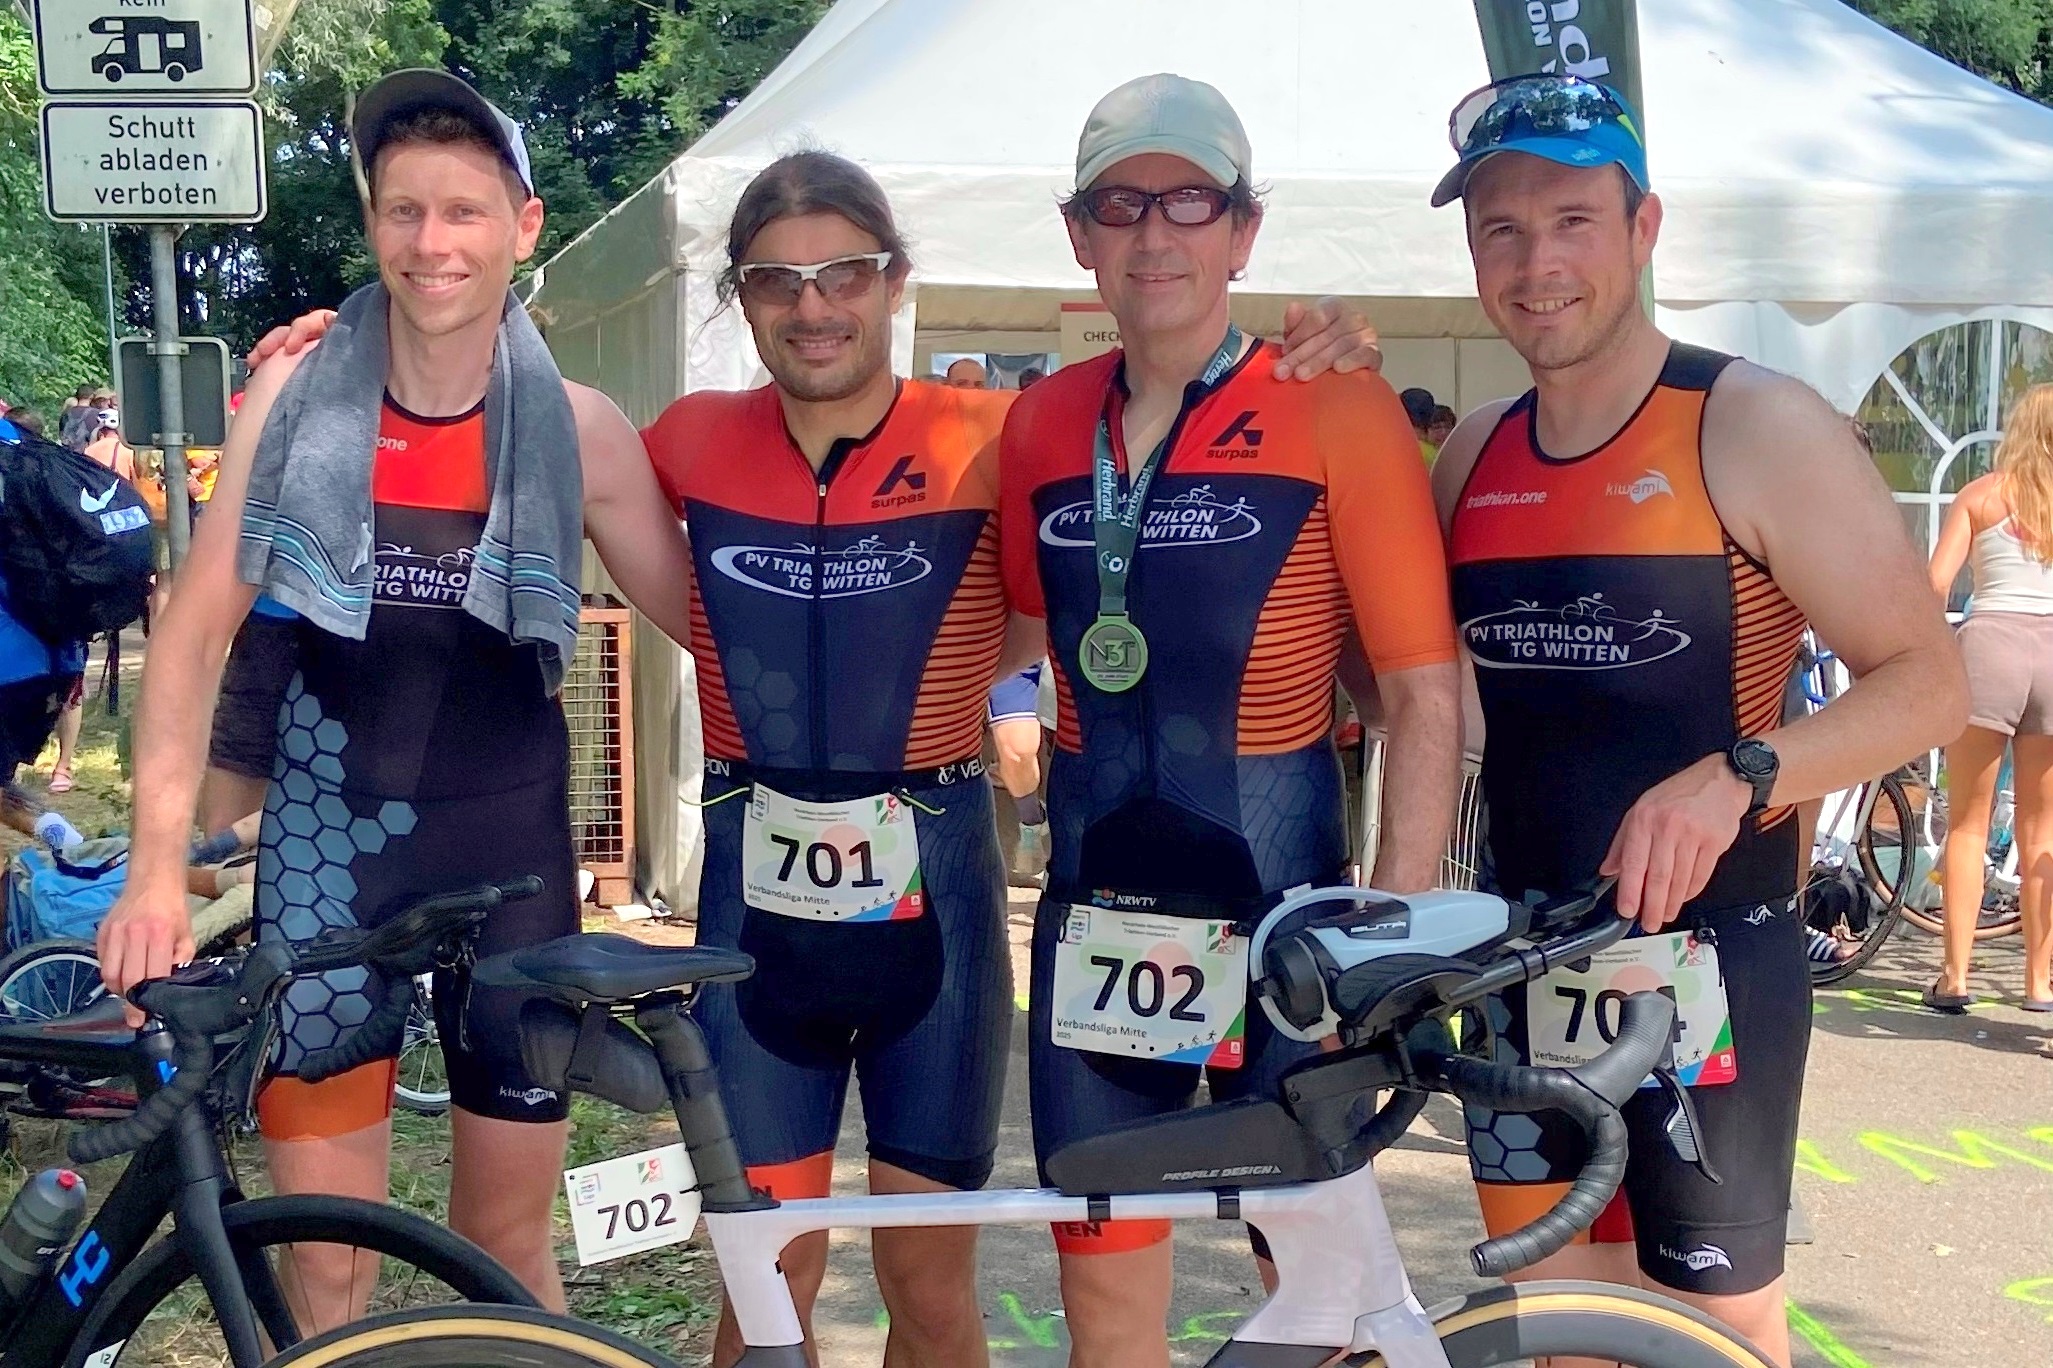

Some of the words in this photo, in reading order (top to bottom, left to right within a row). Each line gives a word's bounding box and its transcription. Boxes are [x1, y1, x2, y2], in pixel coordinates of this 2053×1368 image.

[108, 114, 196, 139] Schutt
[99, 147, 208, 171] abladen
[94, 181, 217, 205] verboten
[1205, 449, 1259, 461] surpas
[1466, 490, 1547, 509] triathlon.one
[1606, 481, 1662, 497] kiwami
[870, 492, 926, 509] surpas
[1058, 510, 1082, 526] PV
[1142, 524, 1219, 539] WITTEN
[745, 552, 772, 568] PV
[773, 557, 888, 577] TRIATHLON
[788, 575, 813, 589] TG
[822, 571, 892, 590] WITTEN
[1470, 626, 1489, 643] PV
[1492, 623, 1615, 643] TRIATHLON
[1510, 641, 1538, 658] TG
[1542, 642, 1630, 662] WITTEN
[770, 833, 884, 889] 701
[747, 881, 802, 903] Verbandsliga
[1115, 894, 1158, 907] NRWTV
[1090, 955, 1206, 1023] 702
[1056, 1017, 1118, 1036] Verbandsliga
[1120, 1026, 1148, 1038] Mitte
[1162, 1170, 1220, 1181] PROFILE
[597, 1192, 677, 1240] 702
[1659, 1243, 1719, 1265] kiwami
